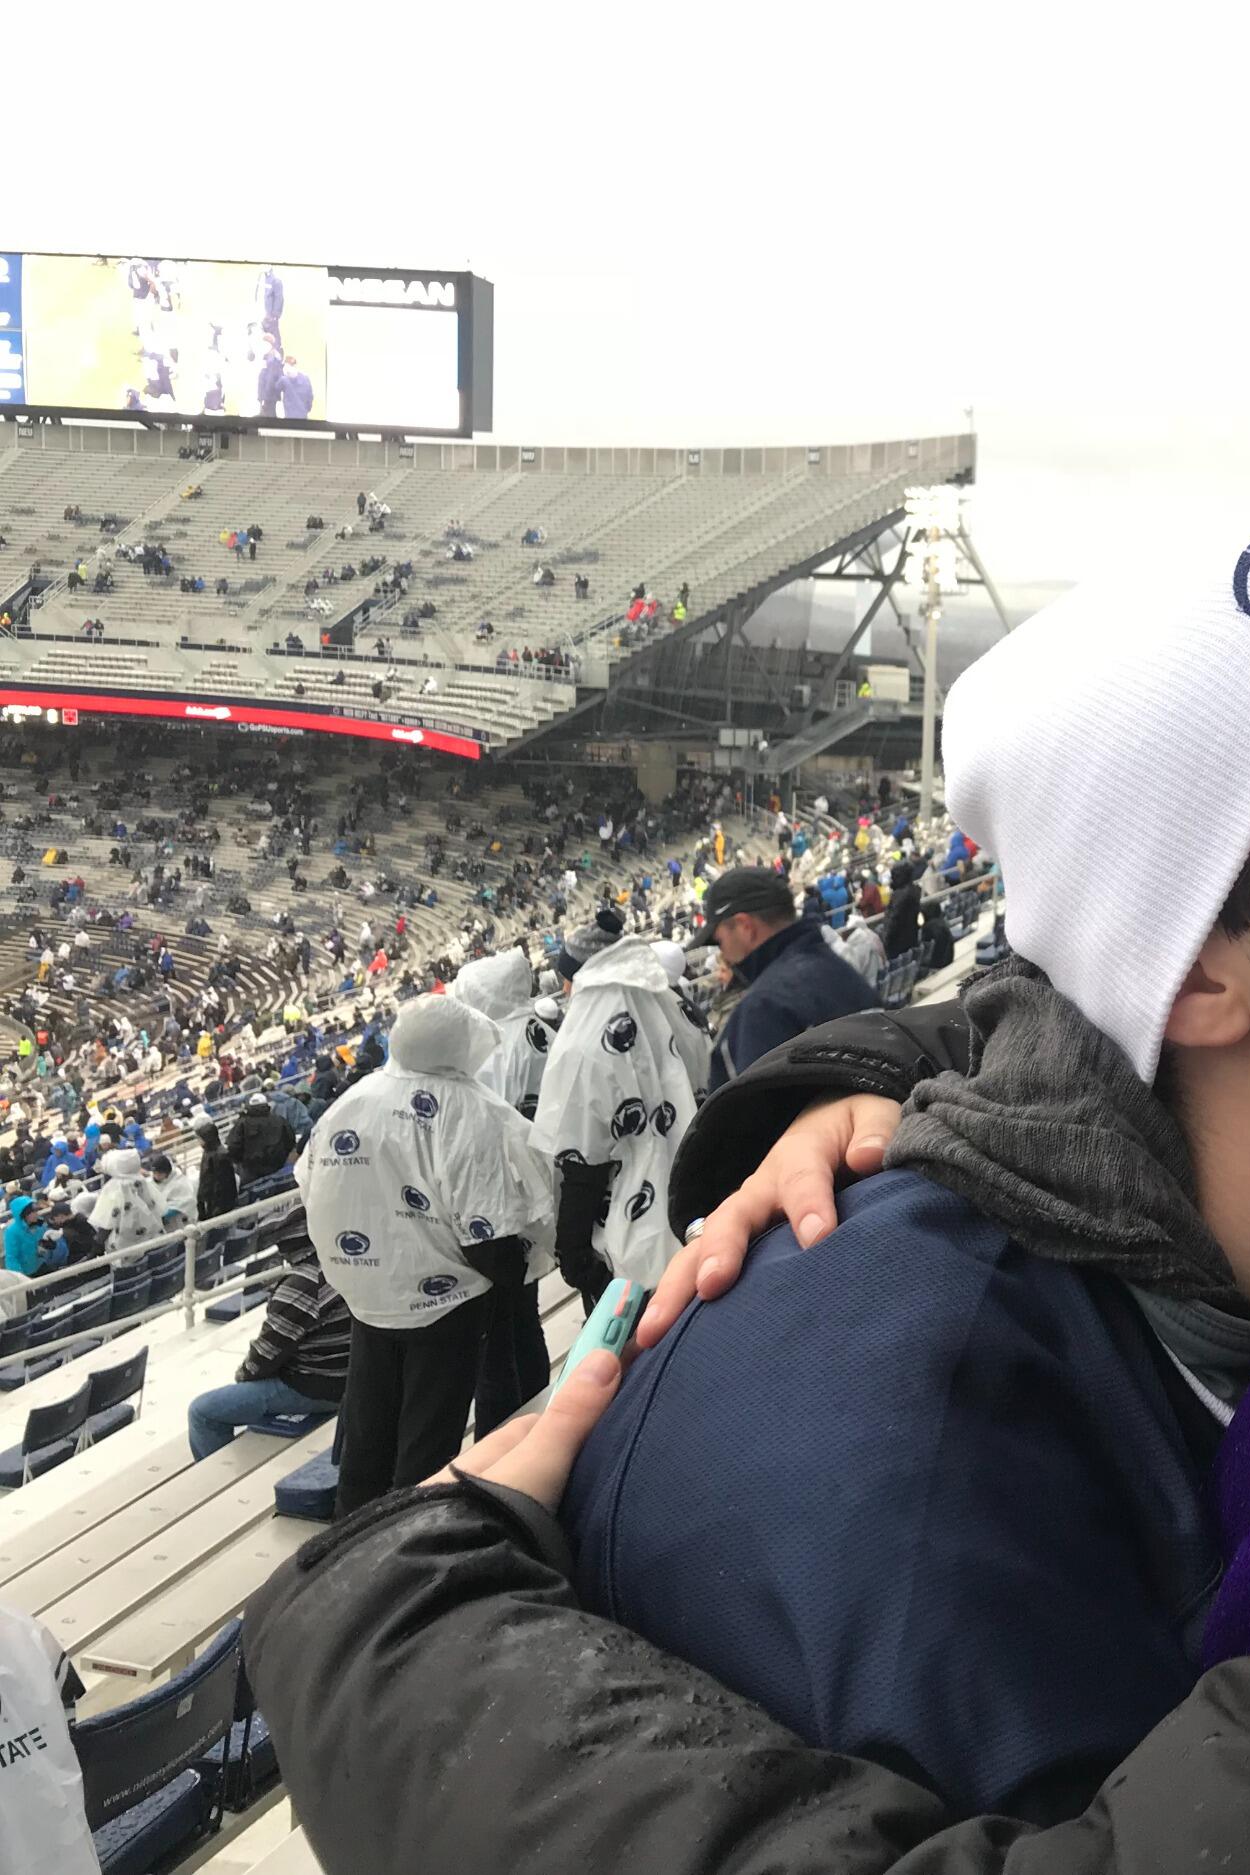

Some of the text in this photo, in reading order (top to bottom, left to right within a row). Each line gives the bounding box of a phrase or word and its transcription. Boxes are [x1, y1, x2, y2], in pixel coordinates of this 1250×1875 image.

[328, 277, 455, 306] NISSAN
[342, 1156, 370, 1167] STATE
[353, 1257, 380, 1267] STATE
[409, 1299, 437, 1311] PENN
